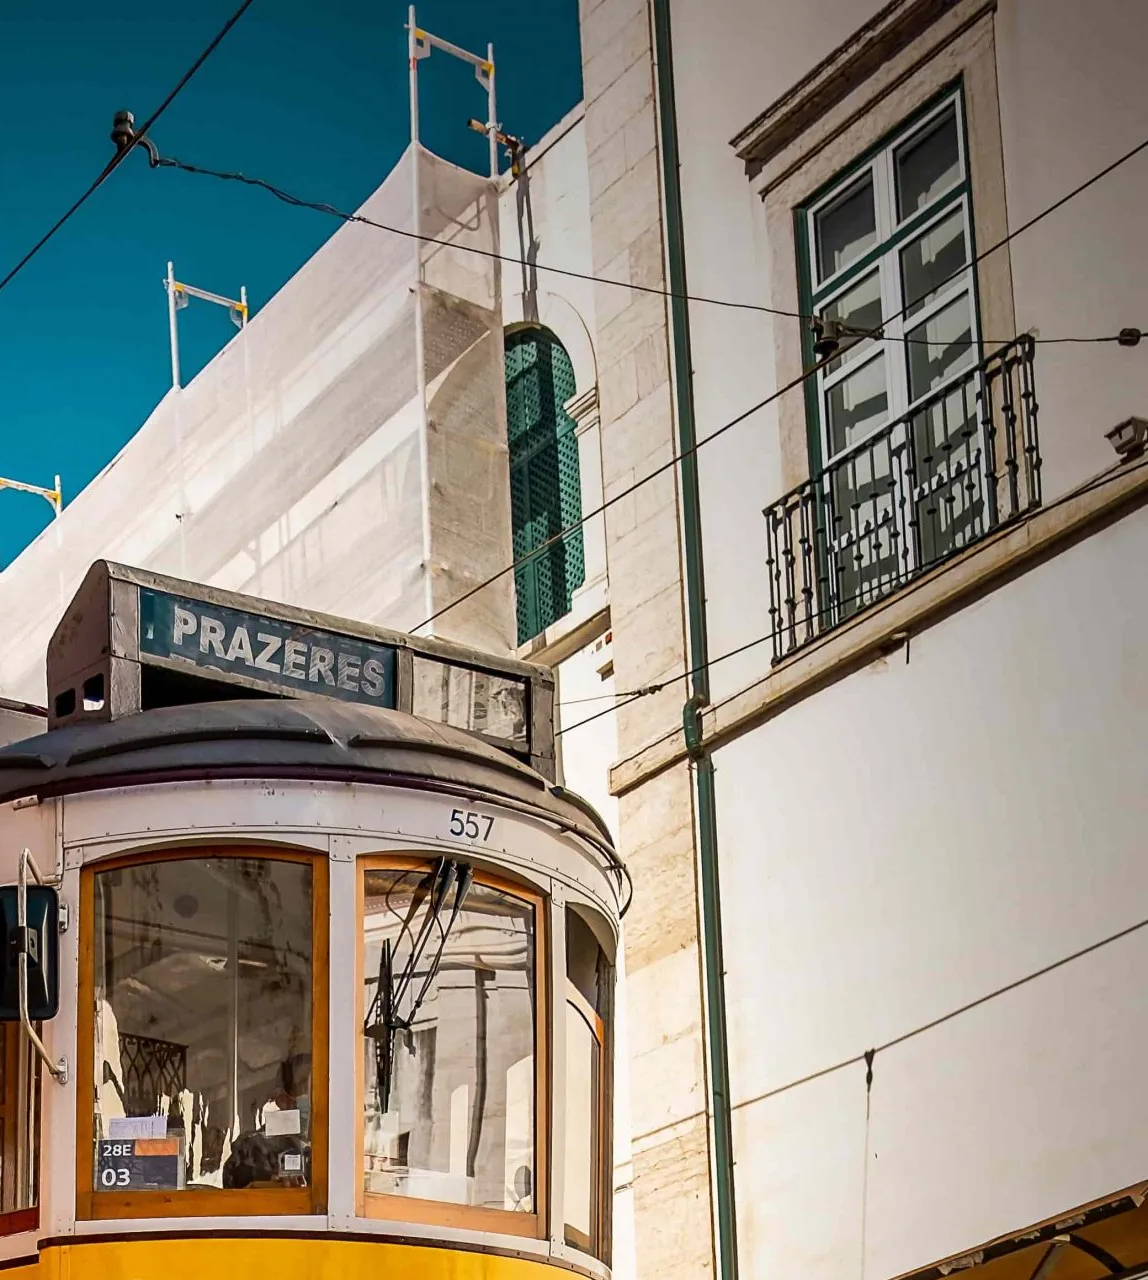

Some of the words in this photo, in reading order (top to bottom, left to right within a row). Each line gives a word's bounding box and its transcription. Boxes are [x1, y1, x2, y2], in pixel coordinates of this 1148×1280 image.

[173, 602, 385, 698] PRAZERES
[450, 808, 495, 842] 557
[102, 1144, 131, 1156] 28E
[101, 1168, 131, 1187] 03
